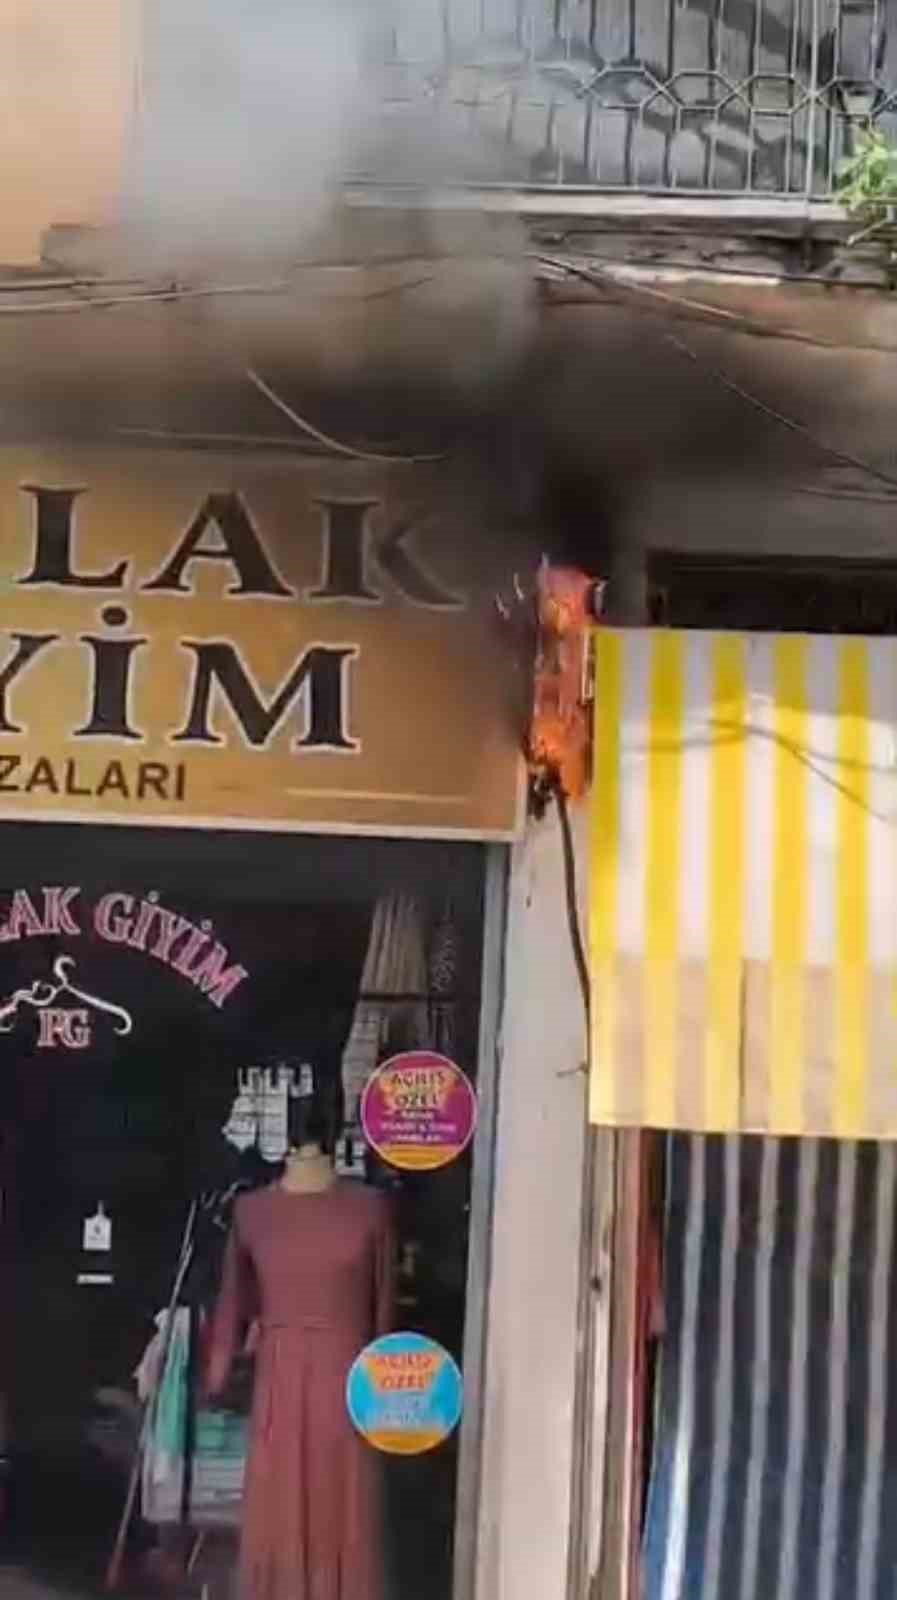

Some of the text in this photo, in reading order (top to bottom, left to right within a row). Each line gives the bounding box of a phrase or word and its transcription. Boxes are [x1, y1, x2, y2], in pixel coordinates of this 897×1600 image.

[18, 482, 466, 609] LAK
[0, 754, 187, 802] ZALARI
[94, 889, 249, 1009] GİYİM
